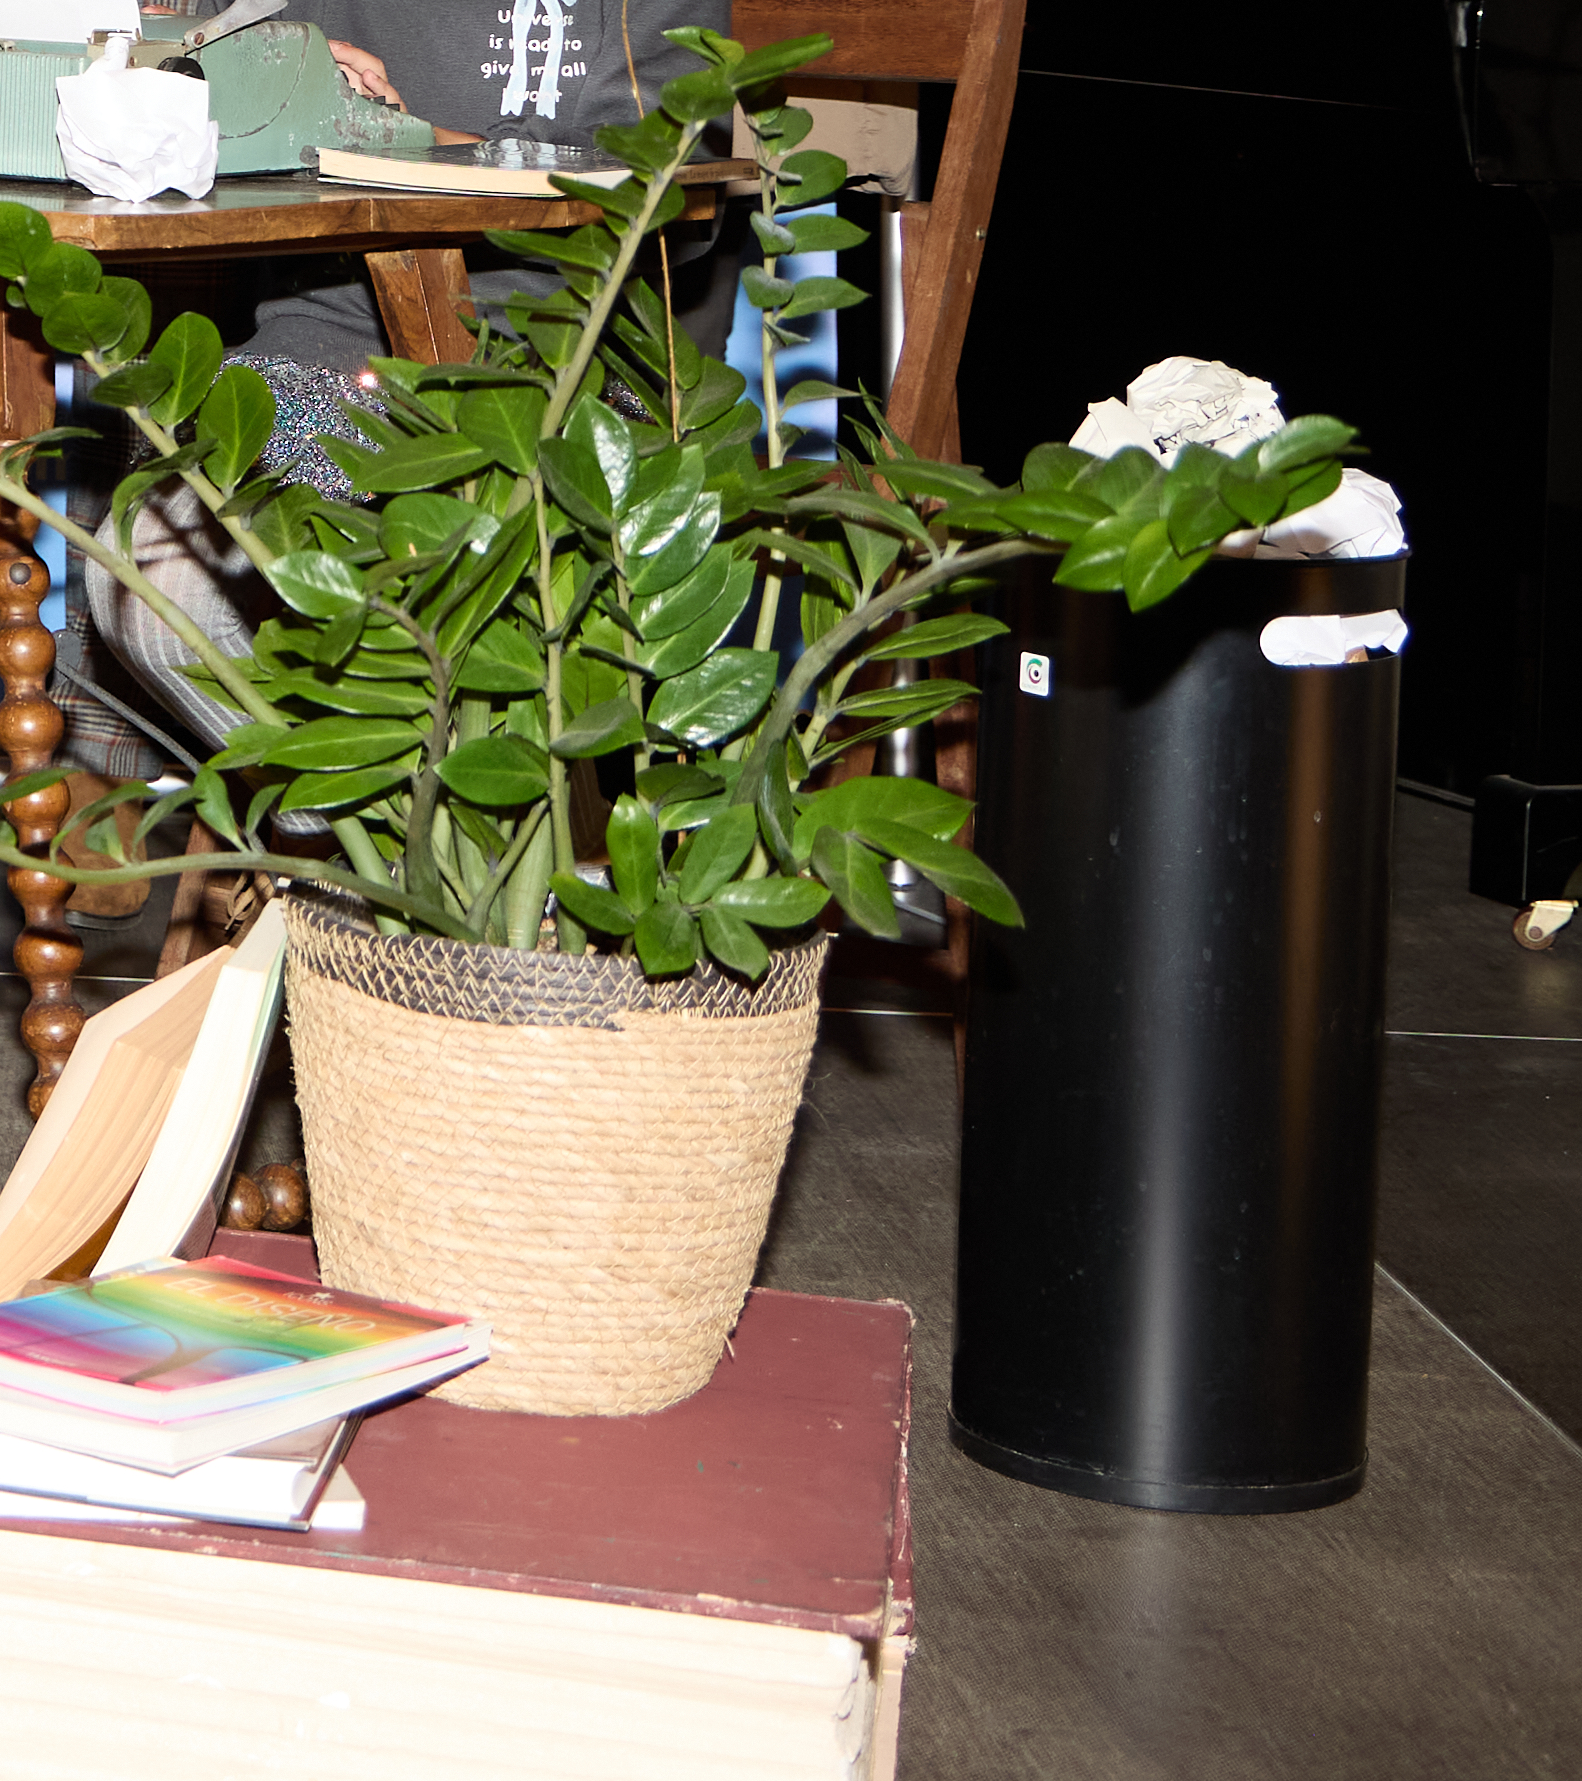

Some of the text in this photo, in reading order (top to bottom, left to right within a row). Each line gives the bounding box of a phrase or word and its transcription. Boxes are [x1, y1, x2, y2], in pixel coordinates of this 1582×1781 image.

[488, 33, 504, 50] is
[564, 38, 583, 51] to
[561, 61, 587, 77] all
